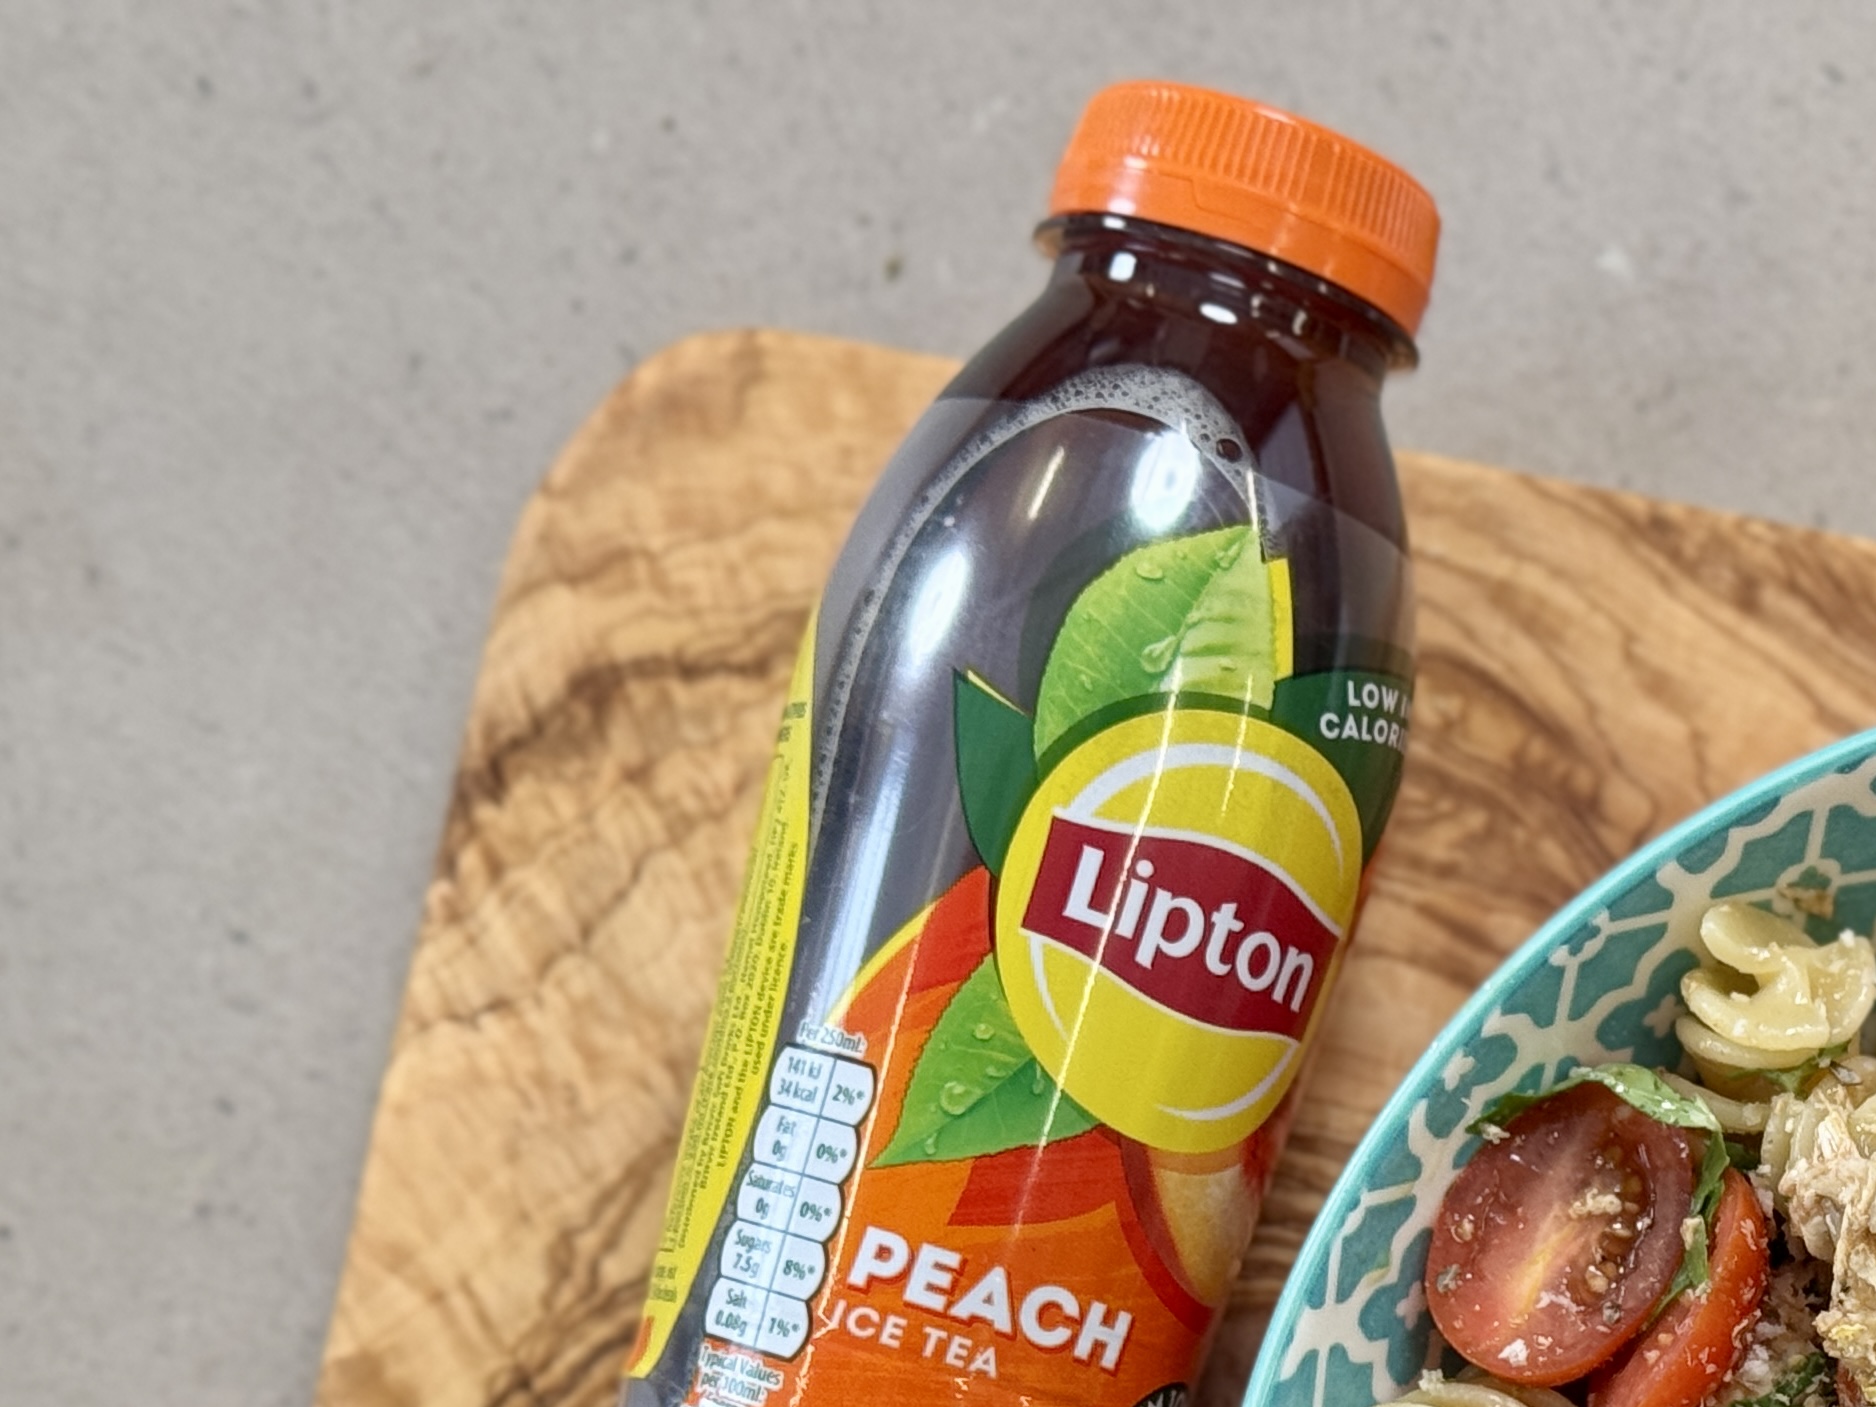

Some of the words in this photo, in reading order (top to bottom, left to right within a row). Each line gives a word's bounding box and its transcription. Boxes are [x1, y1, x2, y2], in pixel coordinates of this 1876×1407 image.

[1347, 680, 1399, 714] LOW
[780, 840, 799, 887] marks
[771, 888, 789, 928] trade
[766, 928, 780, 953] are
[1062, 844, 1314, 1012] Lipton
[755, 954, 774, 1002] device
[742, 1003, 763, 1056] LIPTON
[757, 992, 777, 1039] under
[799, 1021, 820, 1043] Per
[735, 1056, 750, 1085] the
[749, 1039, 766, 1077] used
[787, 1056, 807, 1076] 141
[729, 1085, 744, 1115] and
[777, 1077, 794, 1097] 34
[793, 1081, 819, 1104] kcal
[776, 1114, 797, 1136] Fat
[716, 1116, 737, 1169] LIPTON
[746, 1169, 796, 1198] Saturates
[735, 1228, 773, 1254] Sugars
[725, 1287, 748, 1309] Salt
[846, 1225, 1134, 1372] PEACH
[714, 1309, 748, 1338] 0.08g
[830, 1299, 908, 1349] ICE
[922, 1325, 998, 1380] TEA
[701, 1344, 738, 1373] Typical
[738, 1358, 782, 1386] Values
